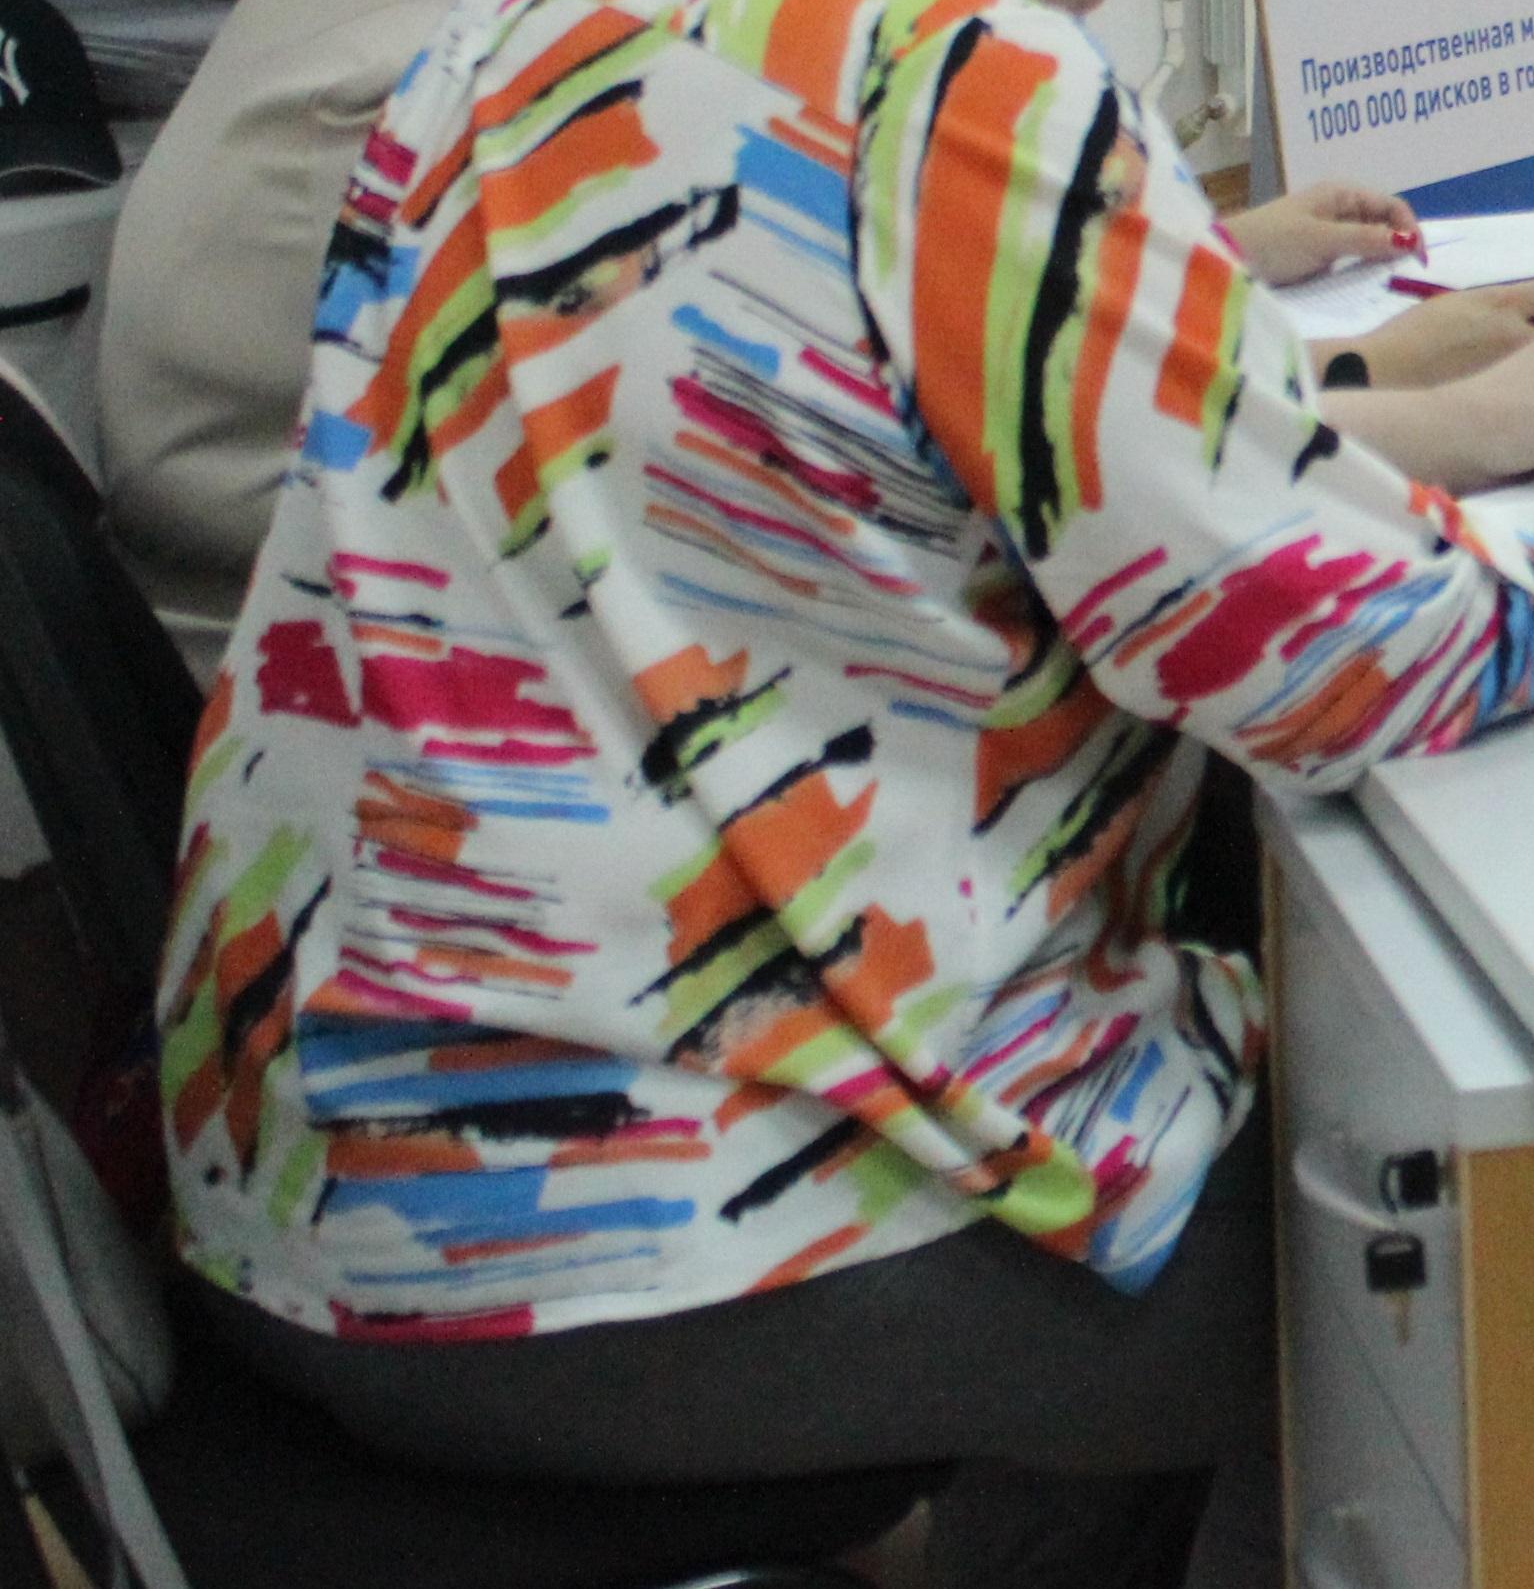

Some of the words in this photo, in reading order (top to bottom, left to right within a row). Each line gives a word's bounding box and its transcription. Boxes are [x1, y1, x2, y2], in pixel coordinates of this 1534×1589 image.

[1301, 21, 1516, 98] Производственная
[1307, 99, 1360, 143] 1000
[1367, 89, 1406, 128] 000
[1413, 74, 1493, 122] дисков
[1499, 71, 1511, 96] в
